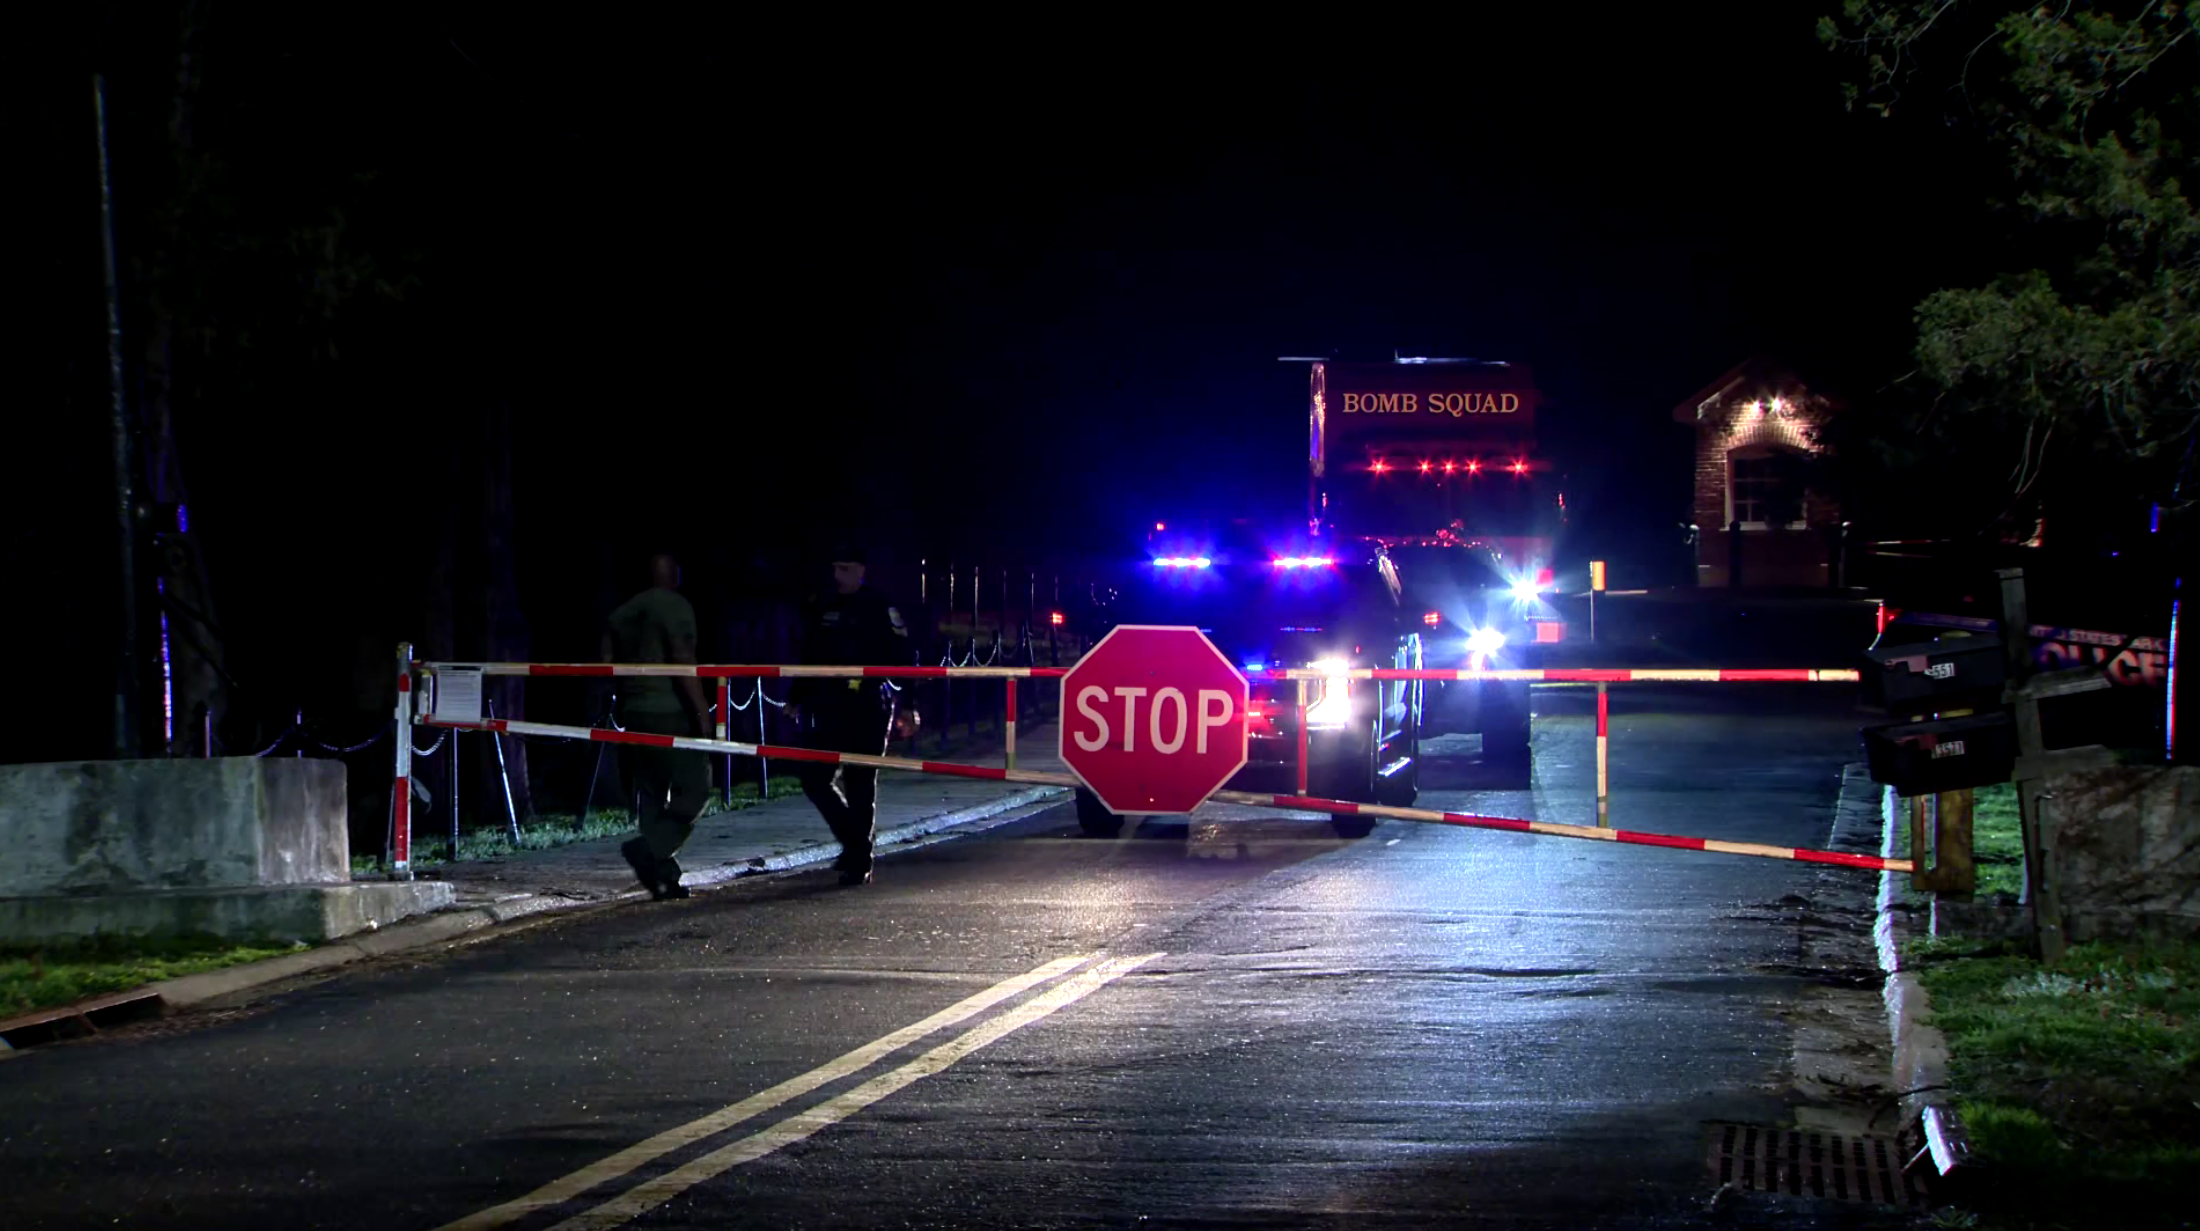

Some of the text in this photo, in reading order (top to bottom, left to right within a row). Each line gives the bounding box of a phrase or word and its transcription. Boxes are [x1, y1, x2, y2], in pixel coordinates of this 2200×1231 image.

[1342, 393, 1519, 417] BOMB SQUAD
[2068, 628, 2123, 647] STATES
[2125, 634, 2167, 652] ARK
[2037, 641, 2168, 687] OLICE
[1073, 685, 1234, 754] STOP
